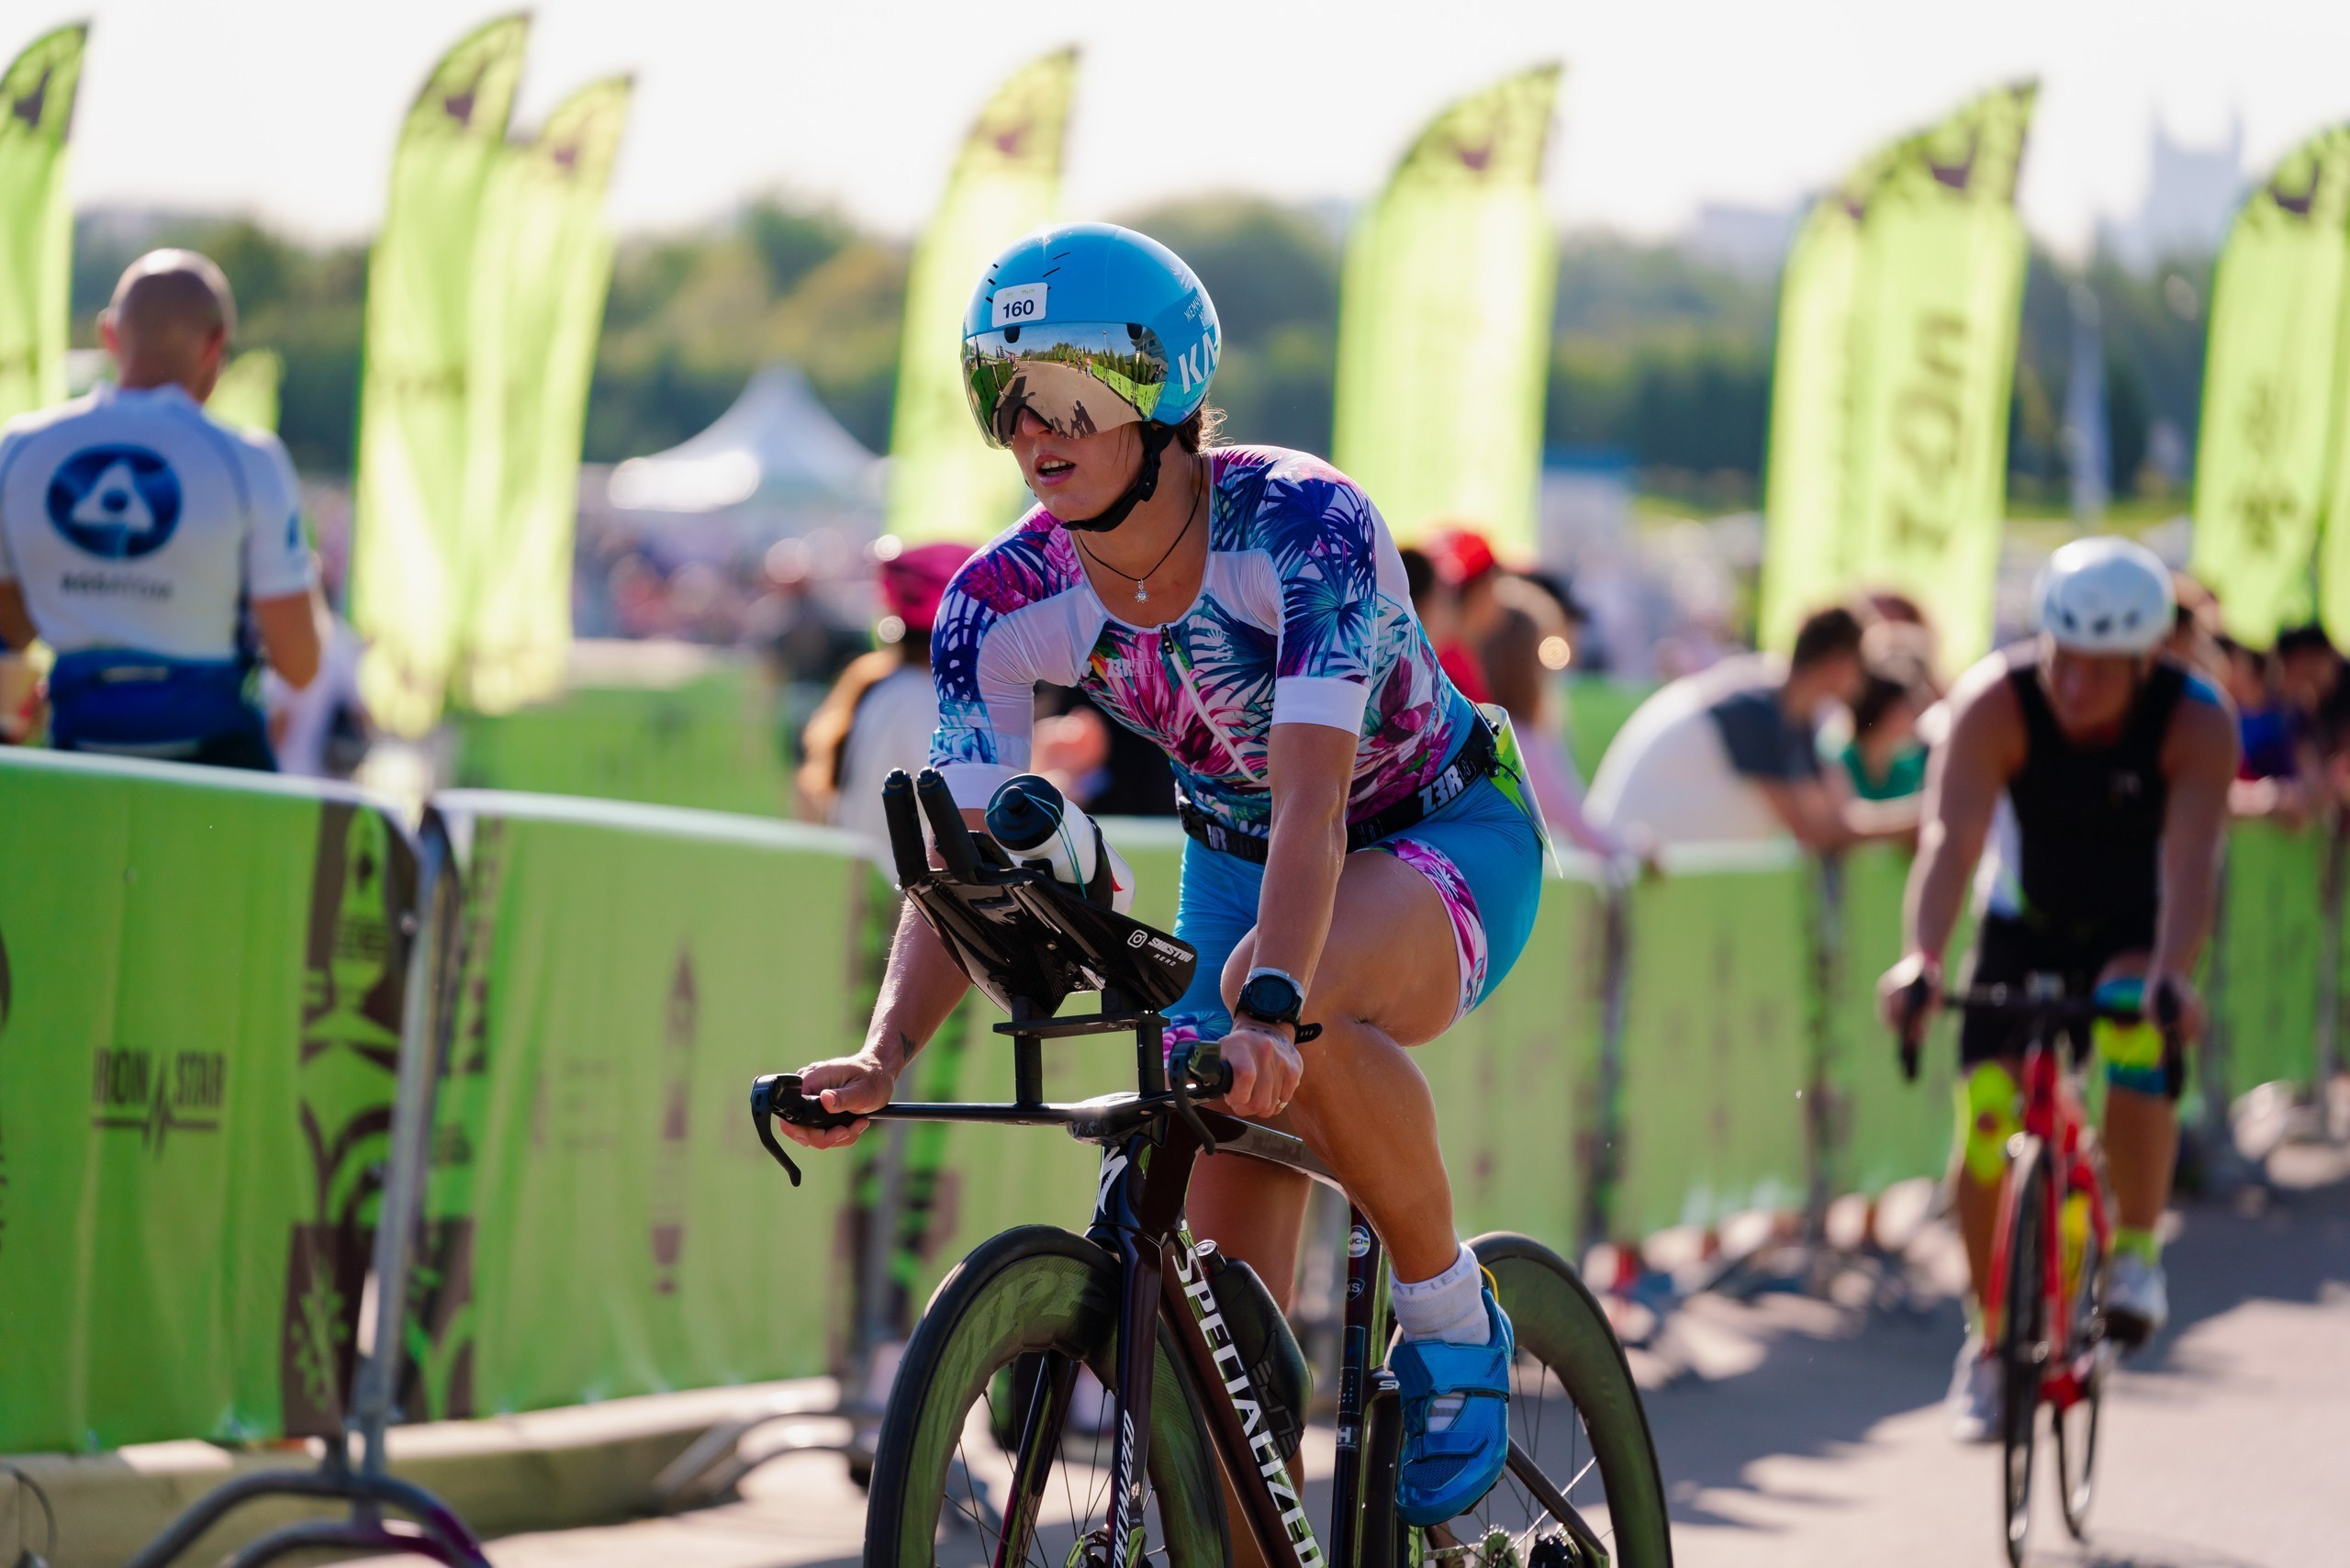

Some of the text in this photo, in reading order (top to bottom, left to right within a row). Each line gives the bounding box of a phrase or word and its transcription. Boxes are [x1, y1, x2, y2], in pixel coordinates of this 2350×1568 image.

[1003, 299, 1035, 319] 160
[1153, 953, 1177, 967] AERO
[95, 1047, 226, 1107] IRON STAR
[1347, 1282, 1360, 1293] XS
[1172, 1247, 1328, 1568] SPECIALIZED
[1252, 1361, 1300, 1457] ELITE
[1113, 1409, 1135, 1568] PECIALIZED
